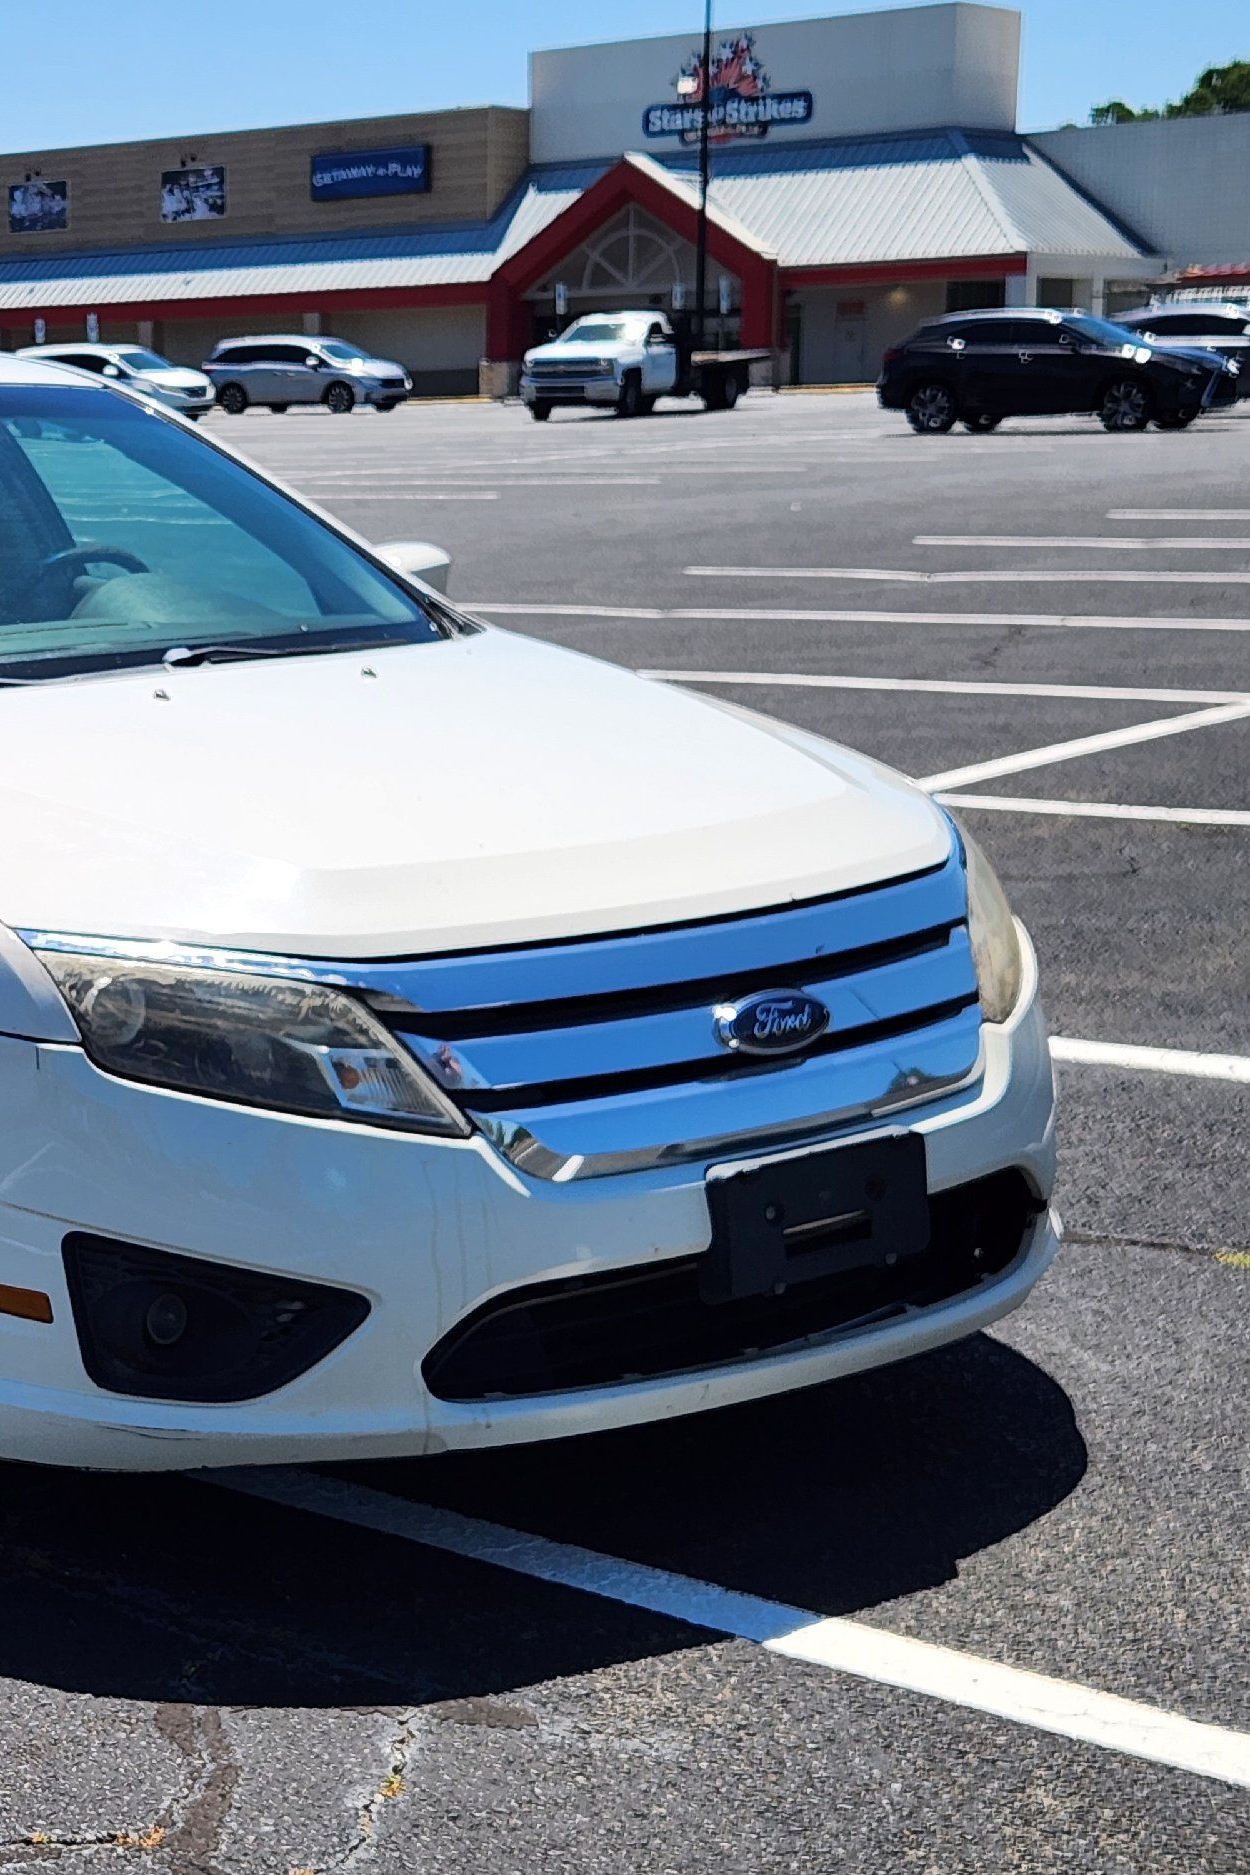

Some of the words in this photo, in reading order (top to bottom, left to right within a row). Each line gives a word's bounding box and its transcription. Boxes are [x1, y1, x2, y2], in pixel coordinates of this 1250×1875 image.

[724, 97, 808, 125] Strikes
[312, 163, 376, 187] GETAWAY
[387, 162, 423, 178] PLAY
[753, 1000, 812, 1039] Ford
